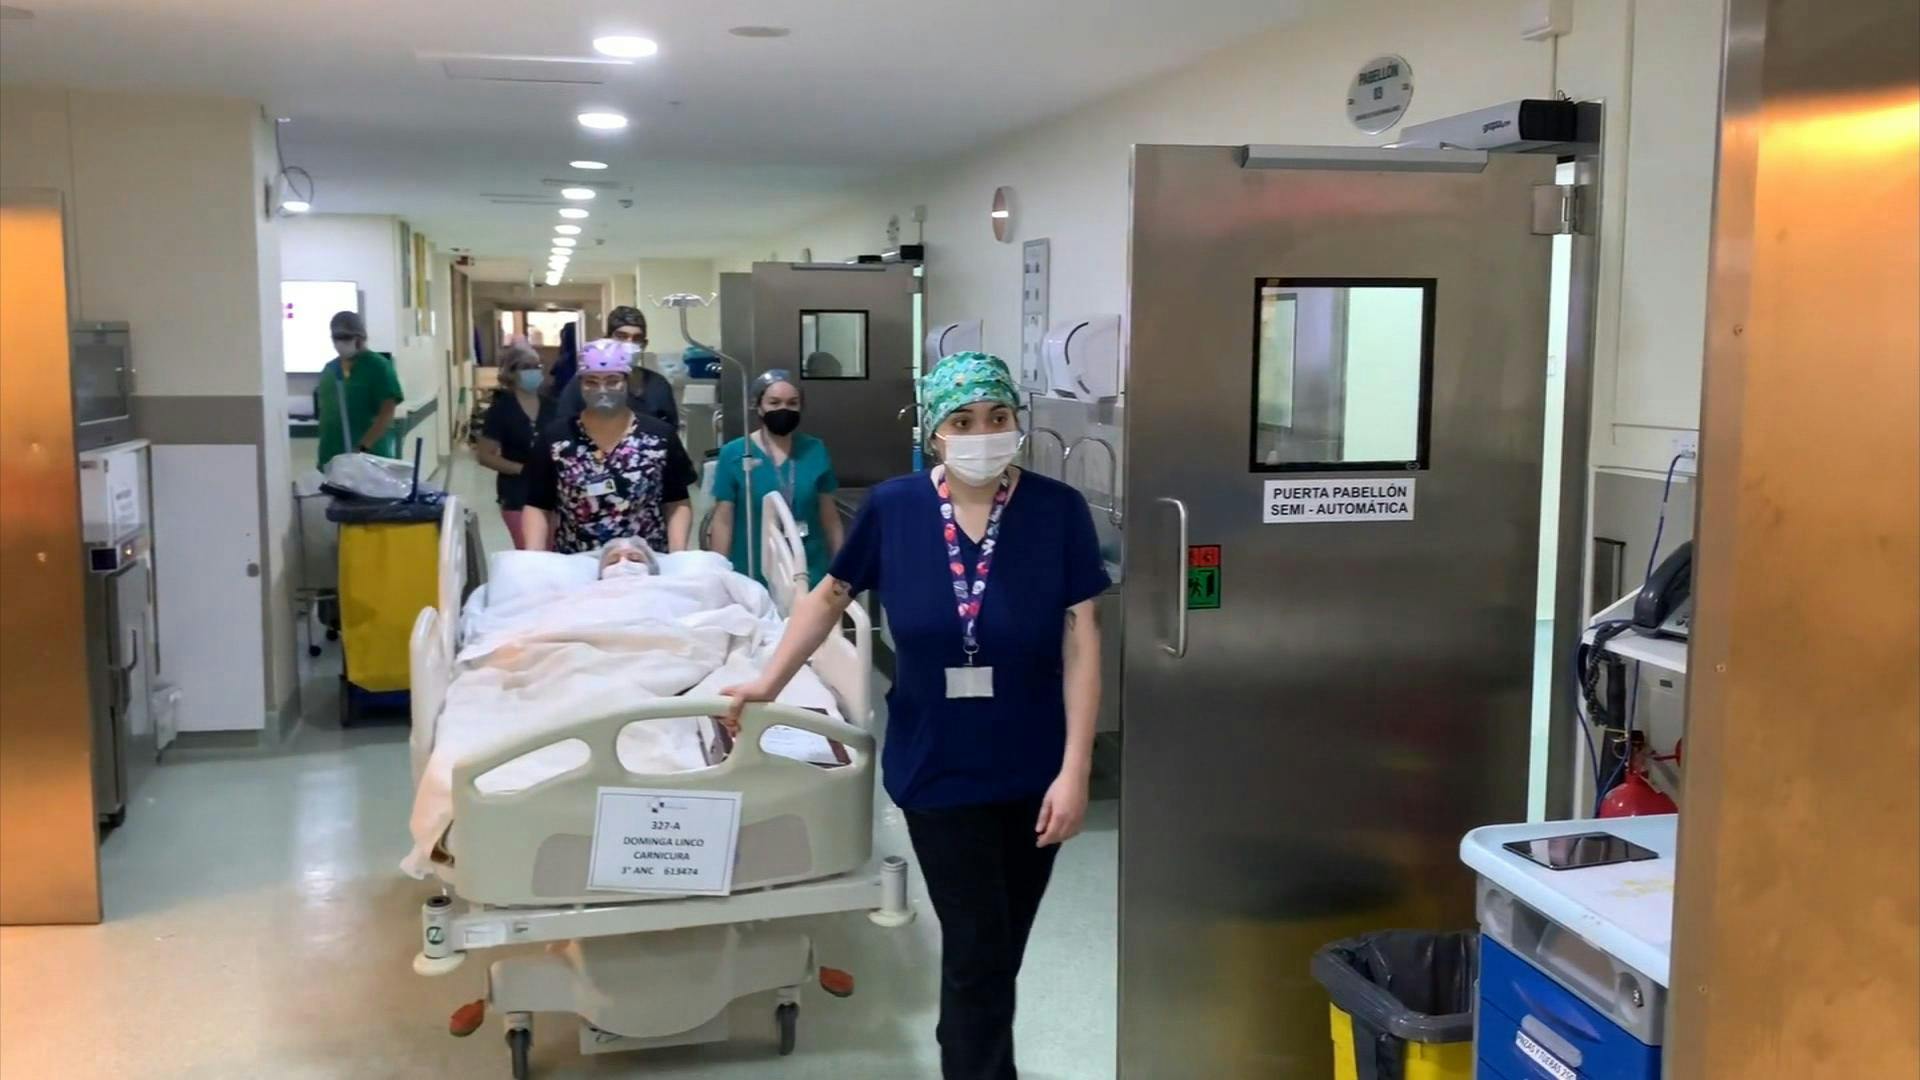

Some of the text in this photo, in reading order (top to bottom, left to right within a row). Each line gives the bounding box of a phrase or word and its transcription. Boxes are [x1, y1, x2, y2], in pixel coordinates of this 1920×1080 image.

[1273, 484, 1407, 500] PUERTA PABELLÓN
[1271, 503, 1305, 516] SEMI
[1316, 500, 1409, 515] AUTOMÁTICA
[650, 821, 681, 831] 327-A
[623, 837, 705, 848] DOMINGA LINCO
[633, 851, 691, 861] CARNICURA
[633, 866, 655, 875] ANC
